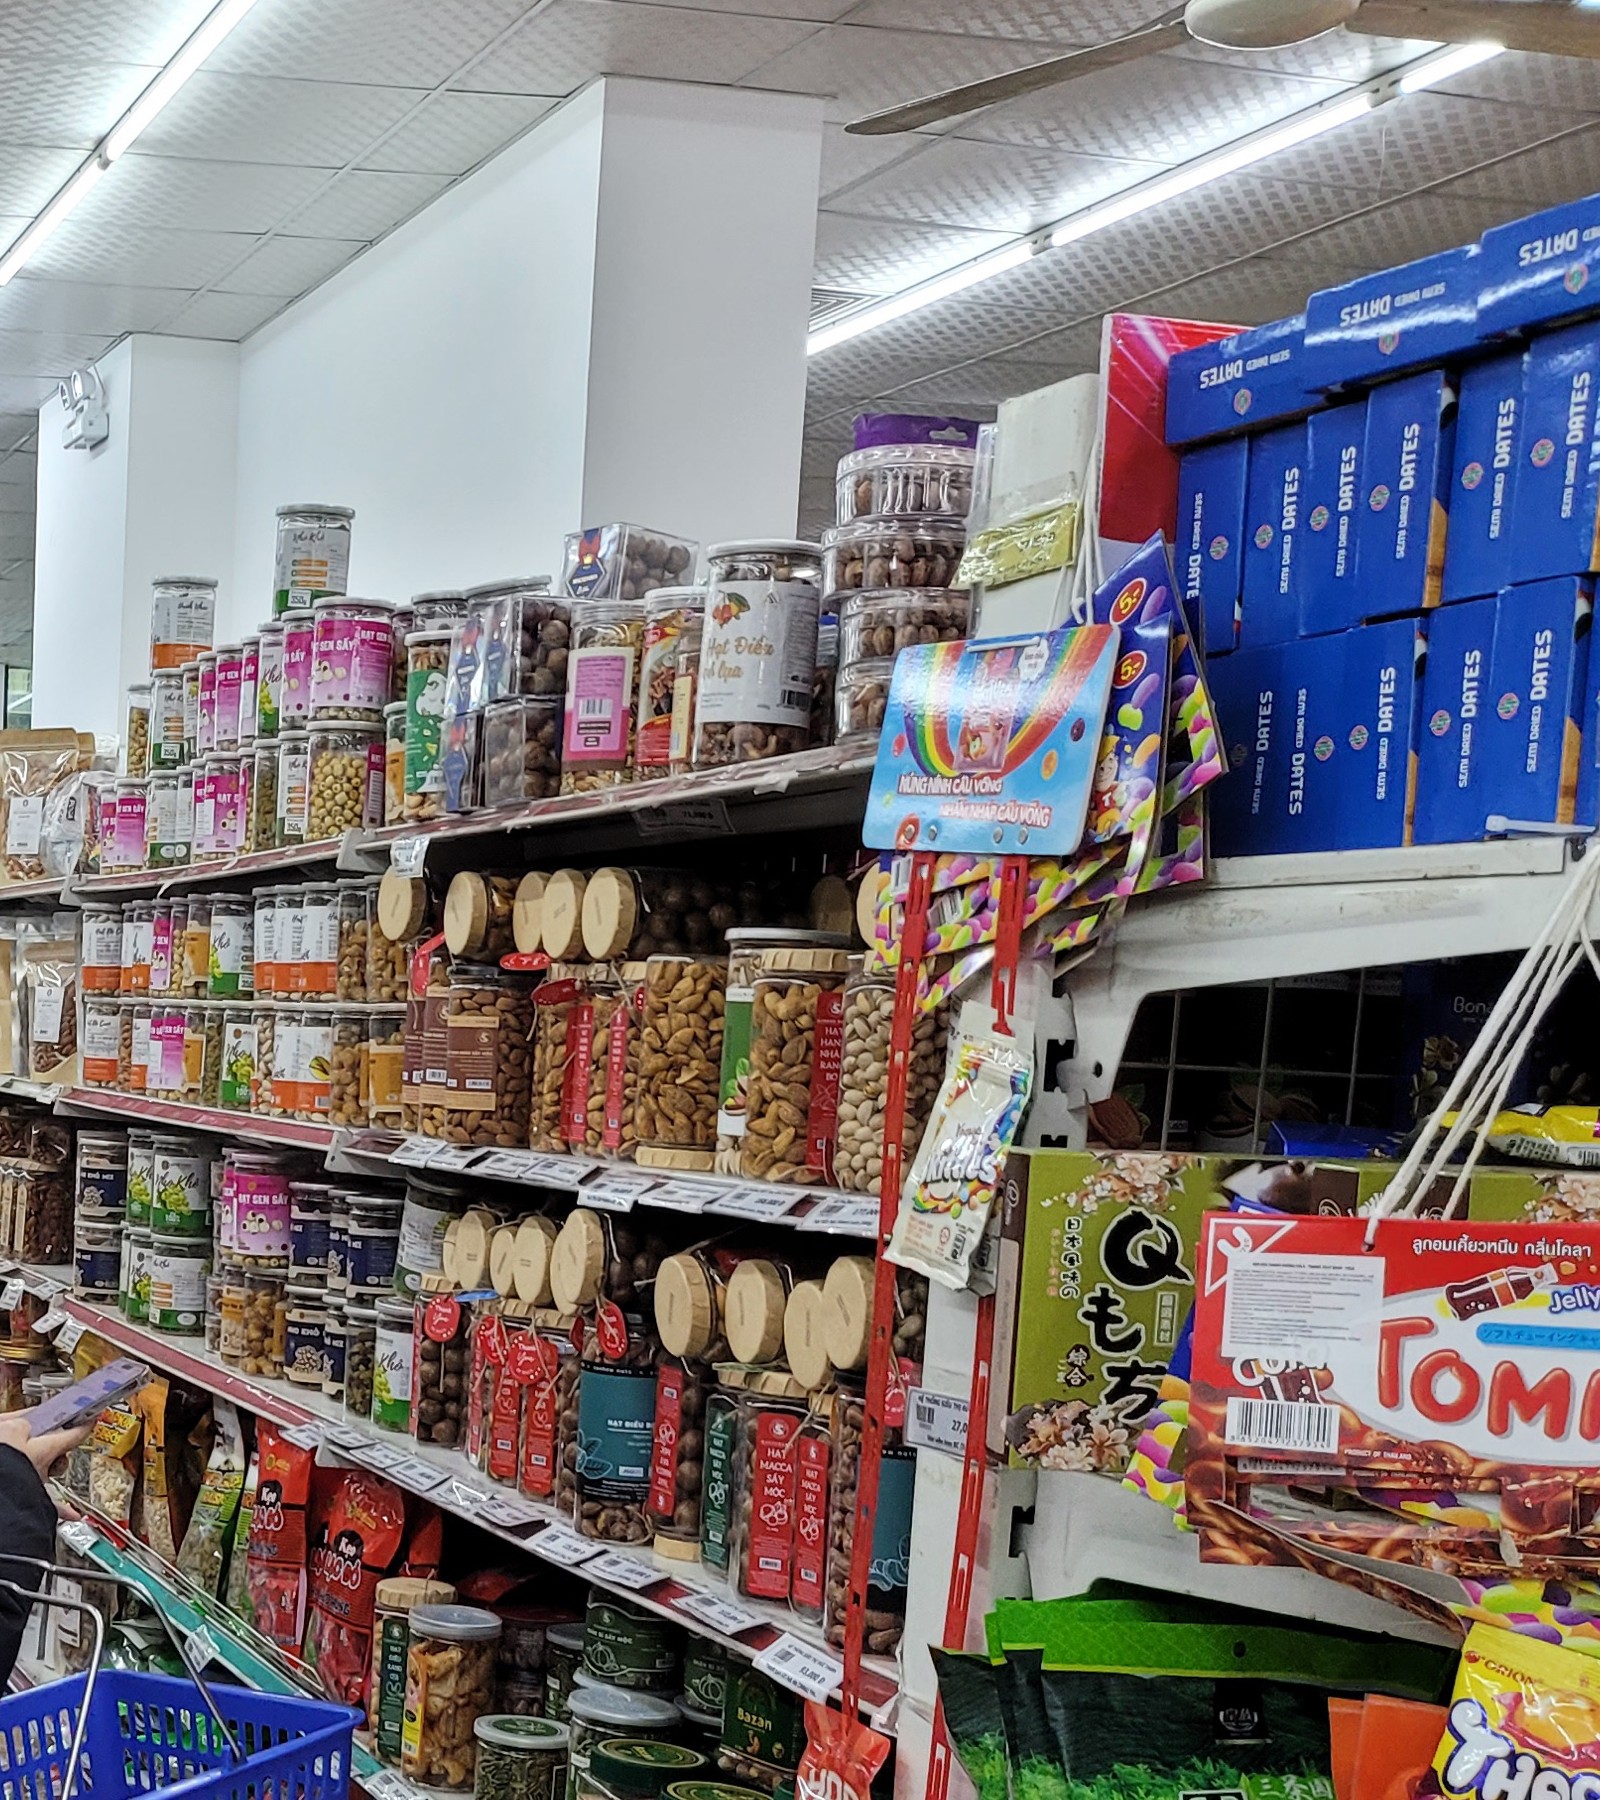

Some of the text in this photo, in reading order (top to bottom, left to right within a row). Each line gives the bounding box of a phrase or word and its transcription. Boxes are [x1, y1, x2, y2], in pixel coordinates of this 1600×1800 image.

[1519, 228, 1579, 266] DATES
[1340, 294, 1391, 327] DATES
[1200, 359, 1243, 389] DATES
[1566, 371, 1591, 445] DATES
[1493, 398, 1515, 469] DATES
[1399, 423, 1420, 491] DATES
[1338, 446, 1356, 511] DATES
[1281, 467, 1299, 531] DATES
[1530, 629, 1552, 700] DATES
[1377, 667, 1396, 733] DATES
[1461, 650, 1481, 718] DATES
[1256, 690, 1273, 751] DATES
[1289, 753, 1305, 815] DATES
[252, 1192, 288, 1206] SEN SẤY
[1412, 1234, 1592, 1258] ลูกอมเคี้ยวหนึบ กลิ่นโคลา
[760, 1460, 793, 1473] MACCA
[767, 1447, 787, 1460] HẠT
[1344, 1449, 1412, 1460] PRODUCT OF THAILAND
[766, 1472, 785, 1484] SẤY
[261, 1487, 277, 1505] Kẹo
[338, 1536, 357, 1558] Kẹo
[1484, 1659, 1535, 1686] ORION
[737, 1706, 773, 1731] Bazan
